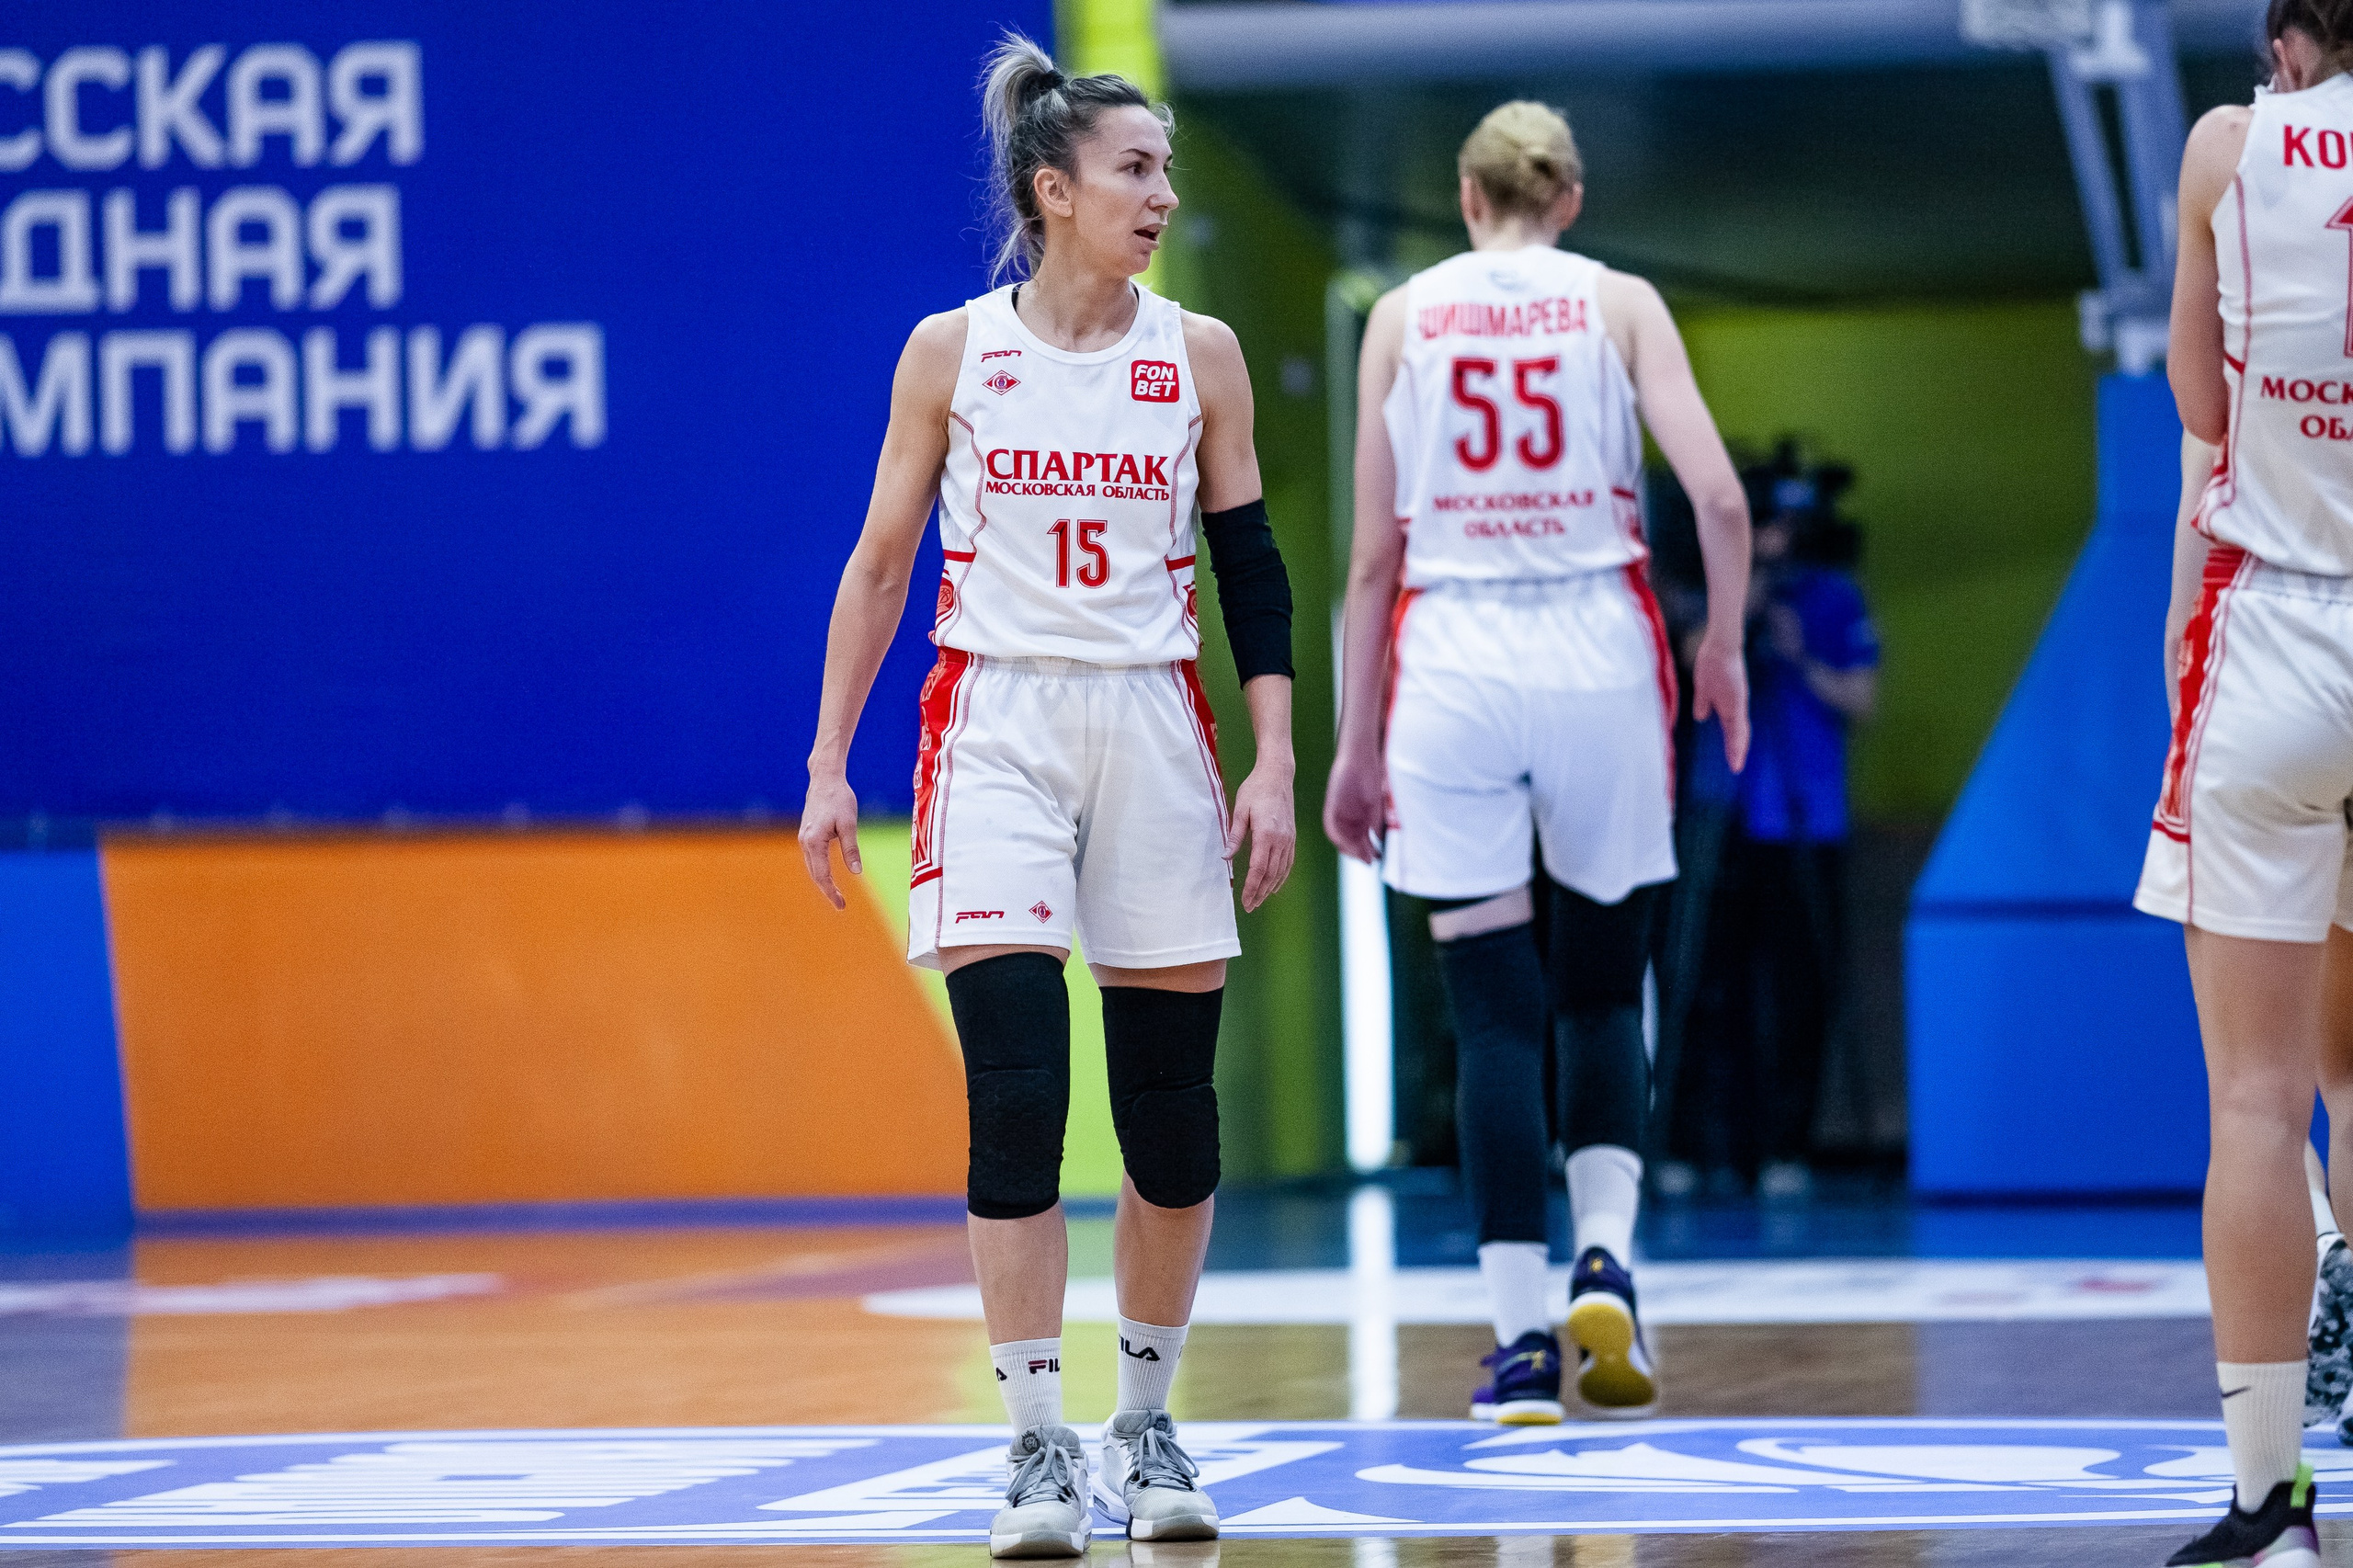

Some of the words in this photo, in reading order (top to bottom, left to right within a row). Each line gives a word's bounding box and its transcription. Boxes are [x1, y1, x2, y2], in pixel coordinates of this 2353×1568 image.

[2284, 124, 2353, 169] КО
[0, 182, 404, 315] ДНАЯ
[1134, 364, 1175, 381] FON
[0, 322, 607, 458] МПАНИЯ
[1134, 380, 1176, 397] BET
[1451, 355, 1564, 472] 55
[2300, 414, 2353, 440] ОБ
[986, 449, 1169, 485] СПАРТАК
[985, 481, 1096, 497] МОСКОВСКАЯ
[1102, 484, 1170, 501] ОБЛАСТЬ
[1433, 489, 1595, 512] МОСКОВСКАЯ
[1464, 517, 1566, 539] ОБЛАСТЬ
[1046, 518, 1110, 588] 15
